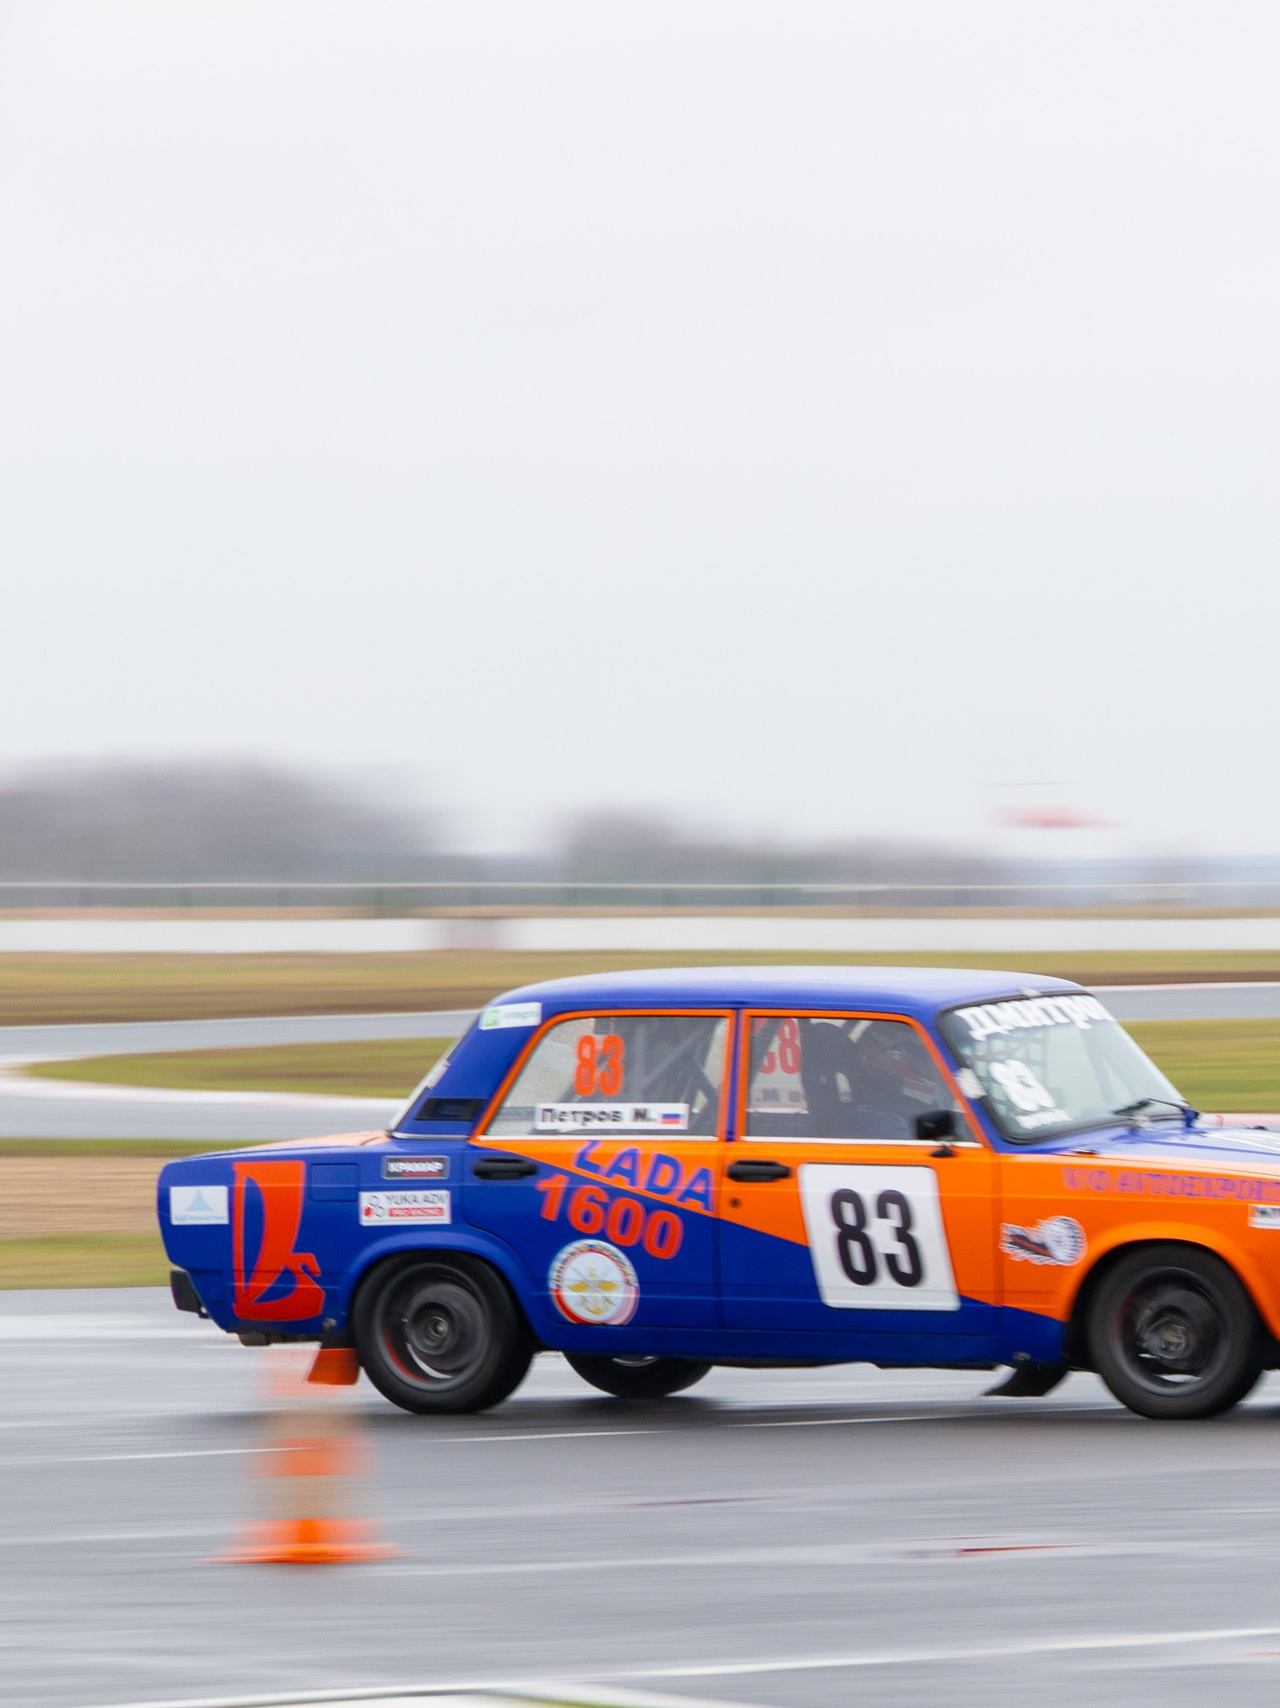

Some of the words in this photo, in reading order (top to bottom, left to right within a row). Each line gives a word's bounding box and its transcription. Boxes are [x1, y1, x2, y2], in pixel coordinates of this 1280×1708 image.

[574, 1034, 625, 1097] 83
[536, 1173, 684, 1260] 1600
[571, 1140, 715, 1213] LADA
[831, 1188, 923, 1287] 83
